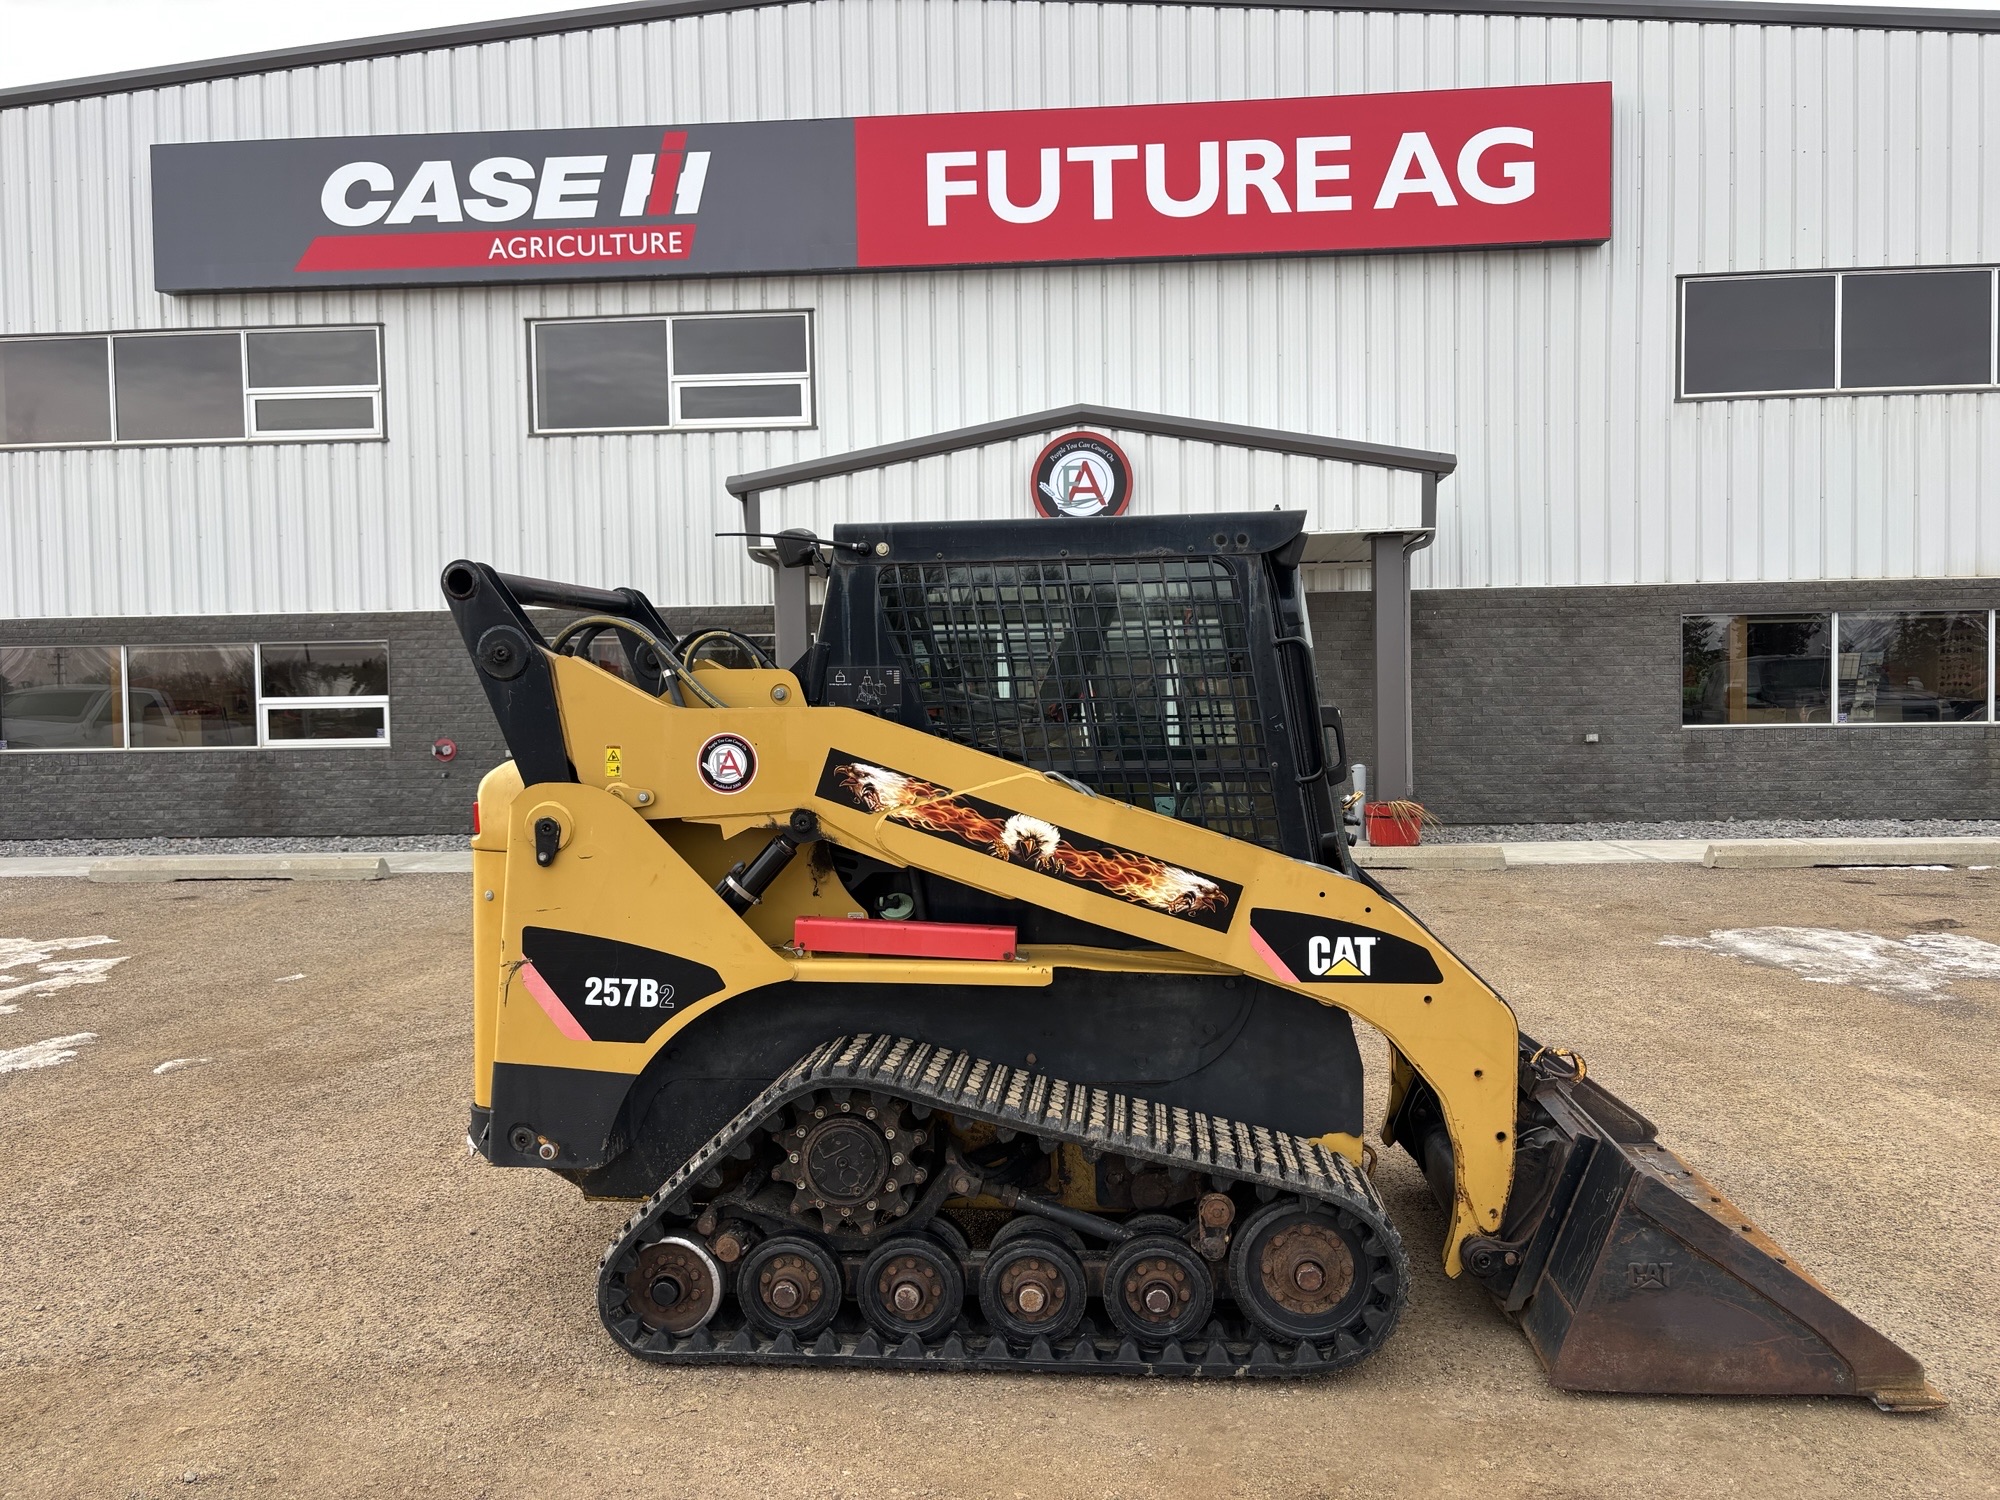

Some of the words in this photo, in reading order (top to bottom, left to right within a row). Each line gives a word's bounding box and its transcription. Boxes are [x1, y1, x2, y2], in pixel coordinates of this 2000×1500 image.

[320, 155, 608, 227] CASE
[926, 135, 1352, 227] FUTURE
[1373, 126, 1535, 210] AG
[488, 231, 683, 260] AGRICULTURE
[1050, 447, 1066, 461] People
[1066, 443, 1078, 451] You
[1091, 442, 1108, 455] Count
[1106, 452, 1116, 463] On
[1308, 935, 1376, 976] CAT
[1627, 1262, 1673, 1288] CAT
